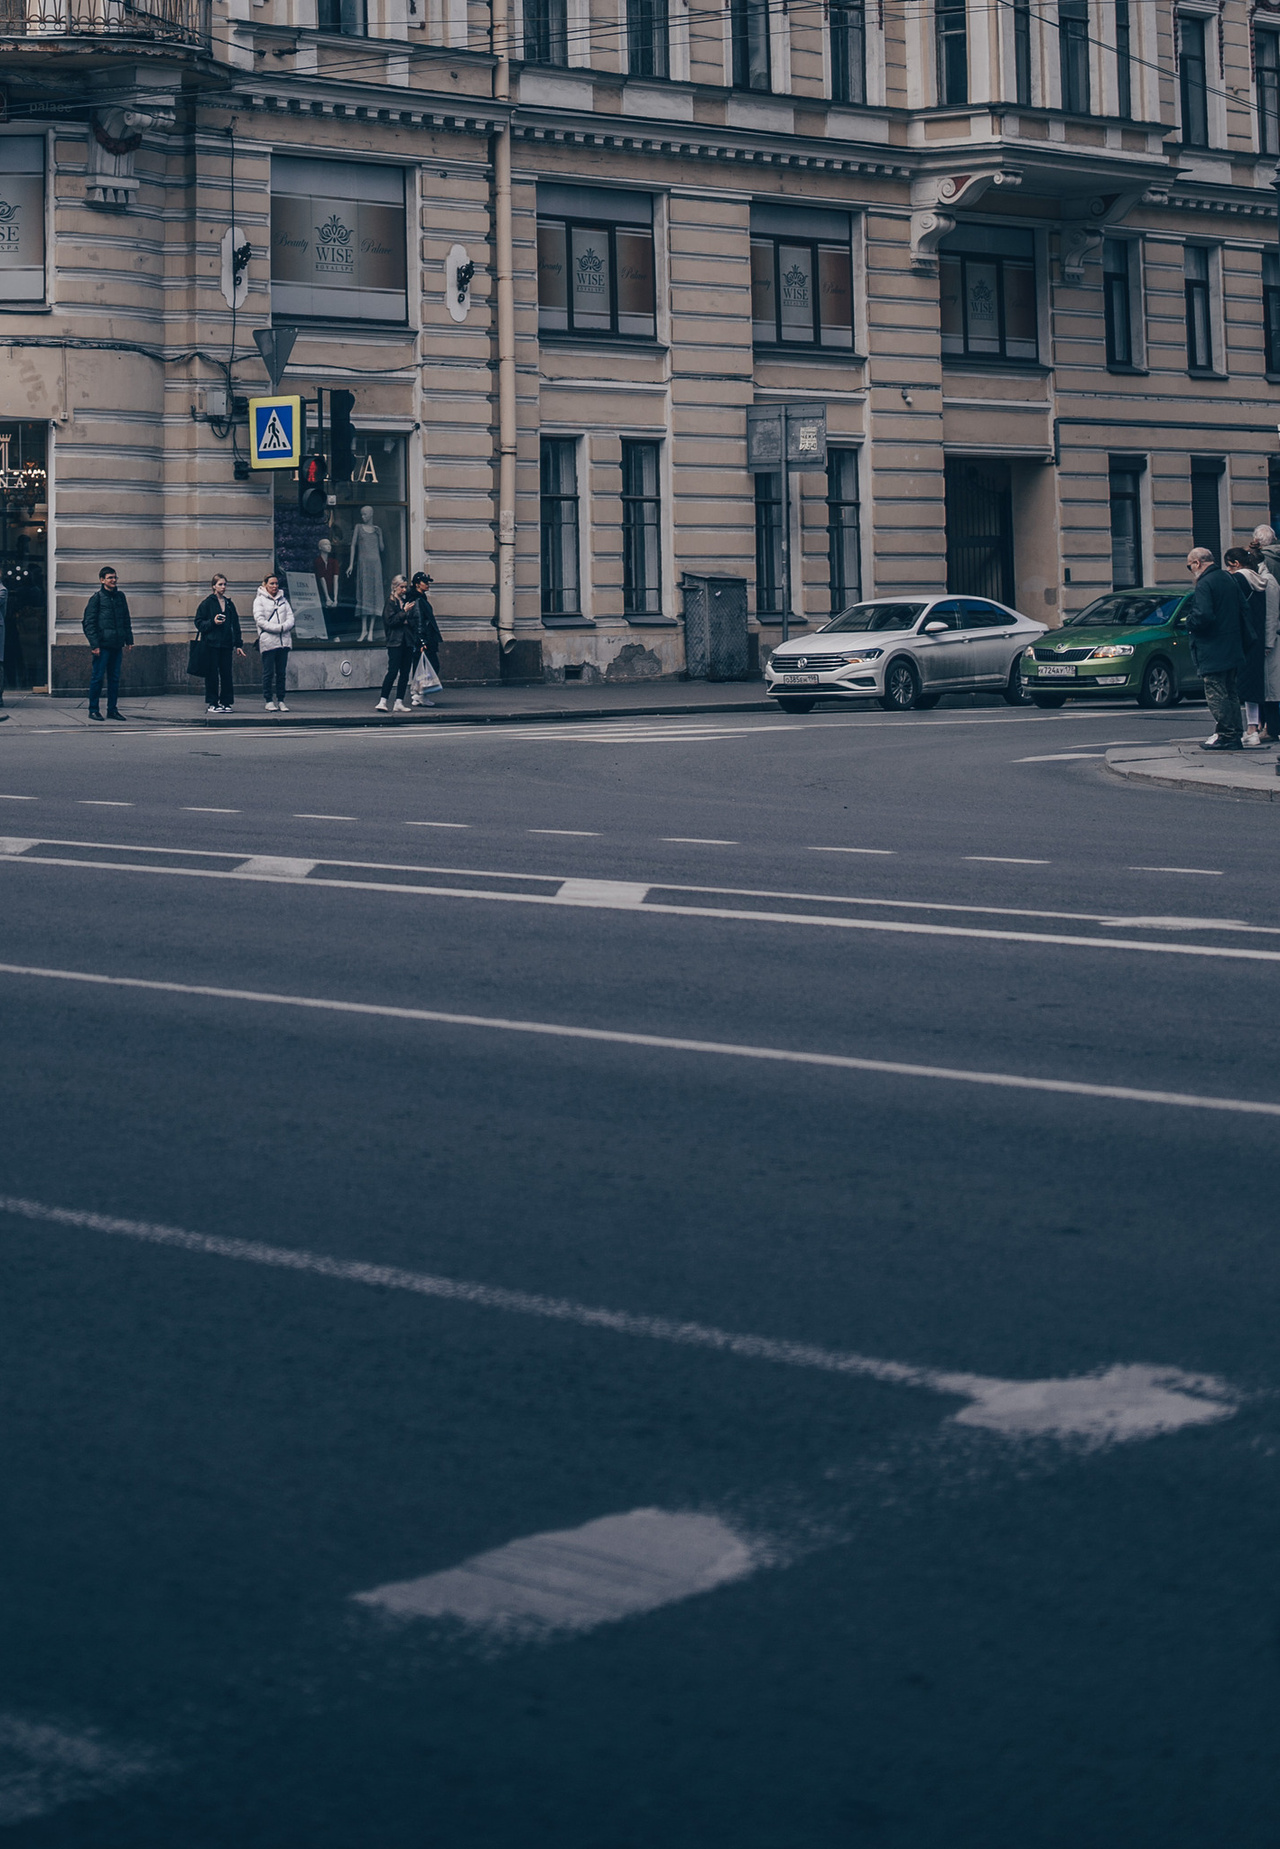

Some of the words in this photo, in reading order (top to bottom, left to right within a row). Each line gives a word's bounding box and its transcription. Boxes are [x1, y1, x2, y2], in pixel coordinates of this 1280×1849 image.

[29, 102, 72, 114] palace
[316, 246, 354, 264] WISE
[576, 272, 606, 287] WISE
[783, 287, 809, 301] WISE
[971, 301, 995, 314] WISE
